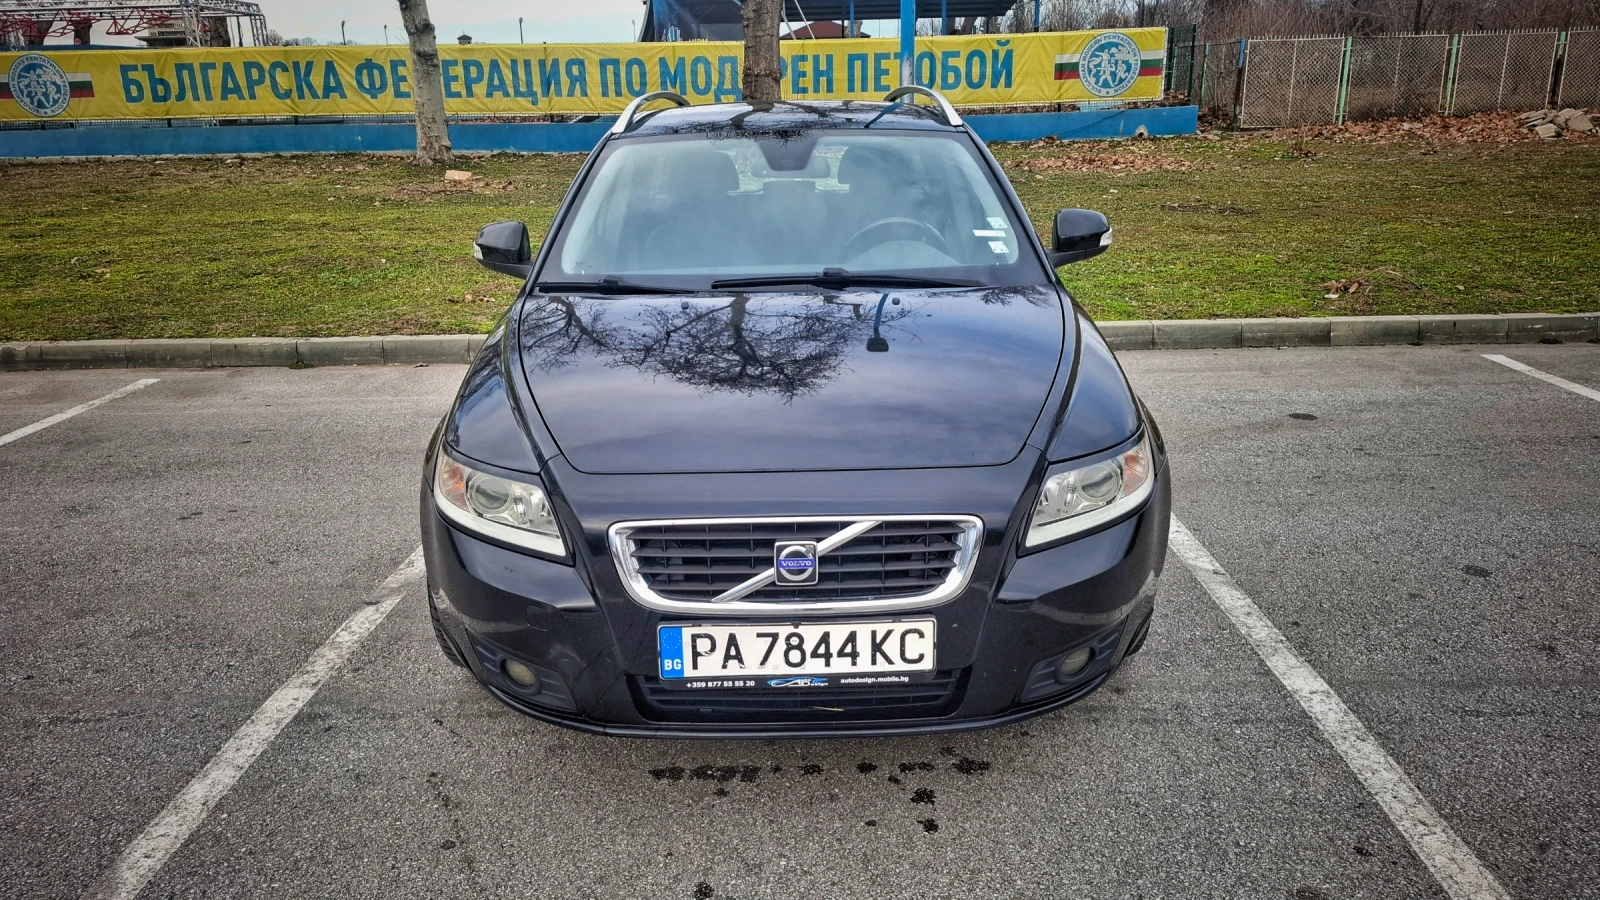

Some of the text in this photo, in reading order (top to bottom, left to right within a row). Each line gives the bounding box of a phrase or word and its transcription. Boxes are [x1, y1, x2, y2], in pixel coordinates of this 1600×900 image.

[1082, 38, 1102, 61] MODERN
[1103, 35, 1137, 57] PENTATHLON
[10, 59, 26, 82] MODERN
[25, 56, 64, 79] PENTATHLON
[50, 80, 69, 114] FEDERATION
[119, 60, 348, 103] БЪЛГАРСКА
[355, 57, 588, 106] ФЕЕРАЦИЯ
[599, 57, 648, 98] ПО
[658, 53, 834, 103] МОДЕН
[1113, 56, 1139, 94] FEDERATION
[664, 659, 682, 670] BG
[840, 676, 909, 684] autodesign.mobile.bg
